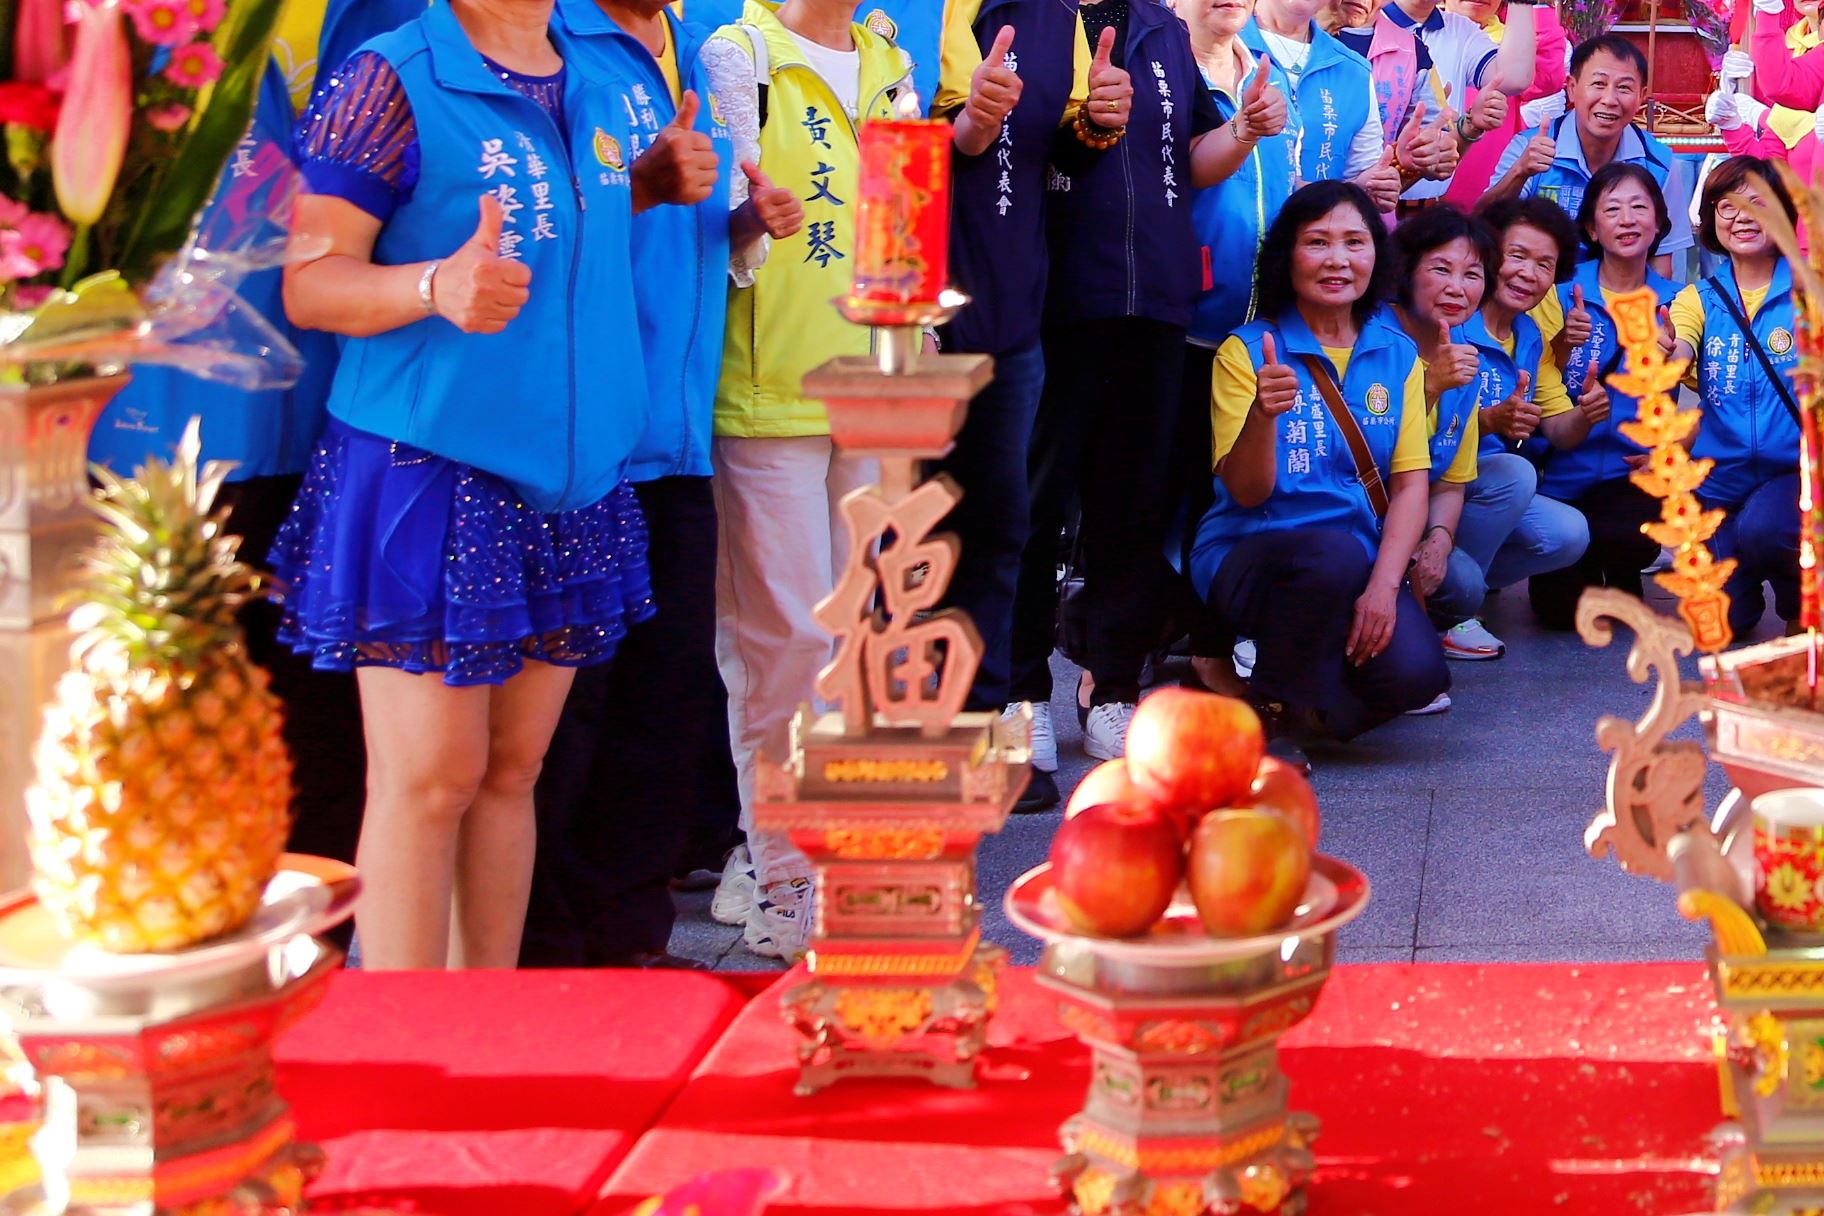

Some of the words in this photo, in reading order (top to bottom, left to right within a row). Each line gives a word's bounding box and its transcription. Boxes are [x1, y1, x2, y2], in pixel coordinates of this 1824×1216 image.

[514, 130, 558, 242] 清華里長
[996, 51, 1019, 218] 苗民代表會
[1151, 60, 1180, 209] 苗栗市民代表會
[1722, 333, 1742, 396] 青苗里長
